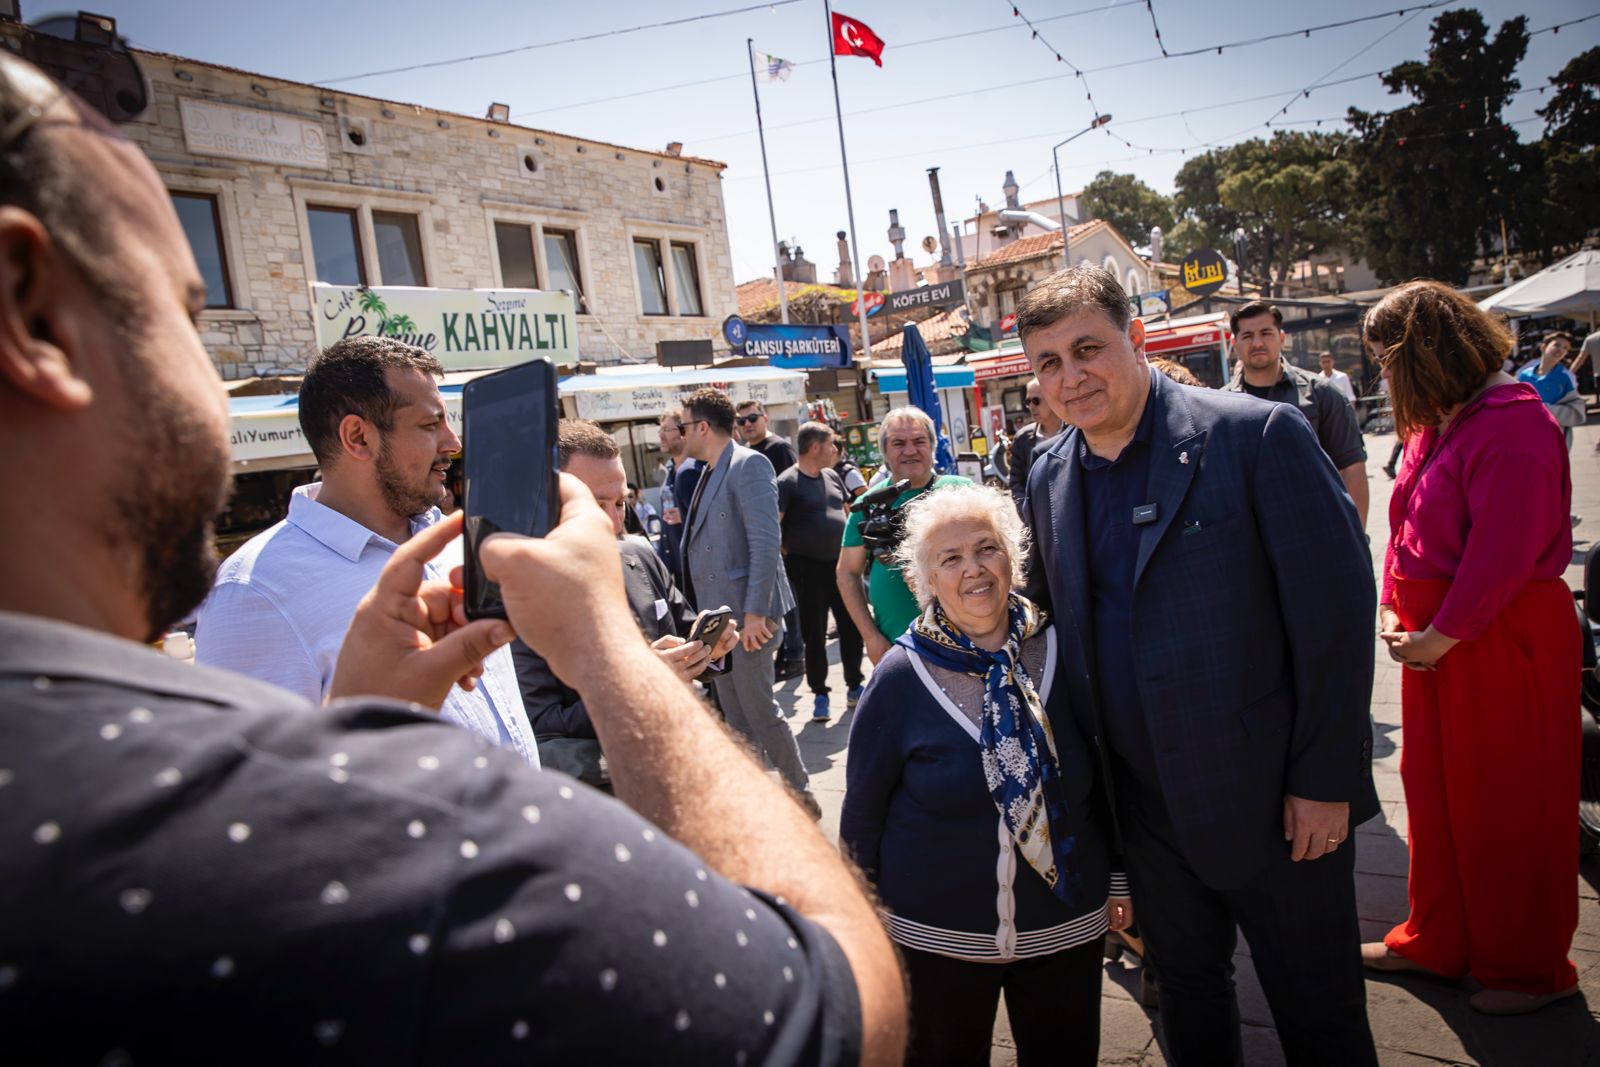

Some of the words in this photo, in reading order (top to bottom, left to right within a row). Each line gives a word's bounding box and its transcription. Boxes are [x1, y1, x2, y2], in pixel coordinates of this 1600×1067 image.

[892, 291, 930, 309] KÖFTE
[931, 285, 951, 300] EVİ
[442, 312, 568, 352] KAHVALTI
[745, 340, 783, 355] CANSU
[785, 336, 841, 358] ŞARKÜTERİ
